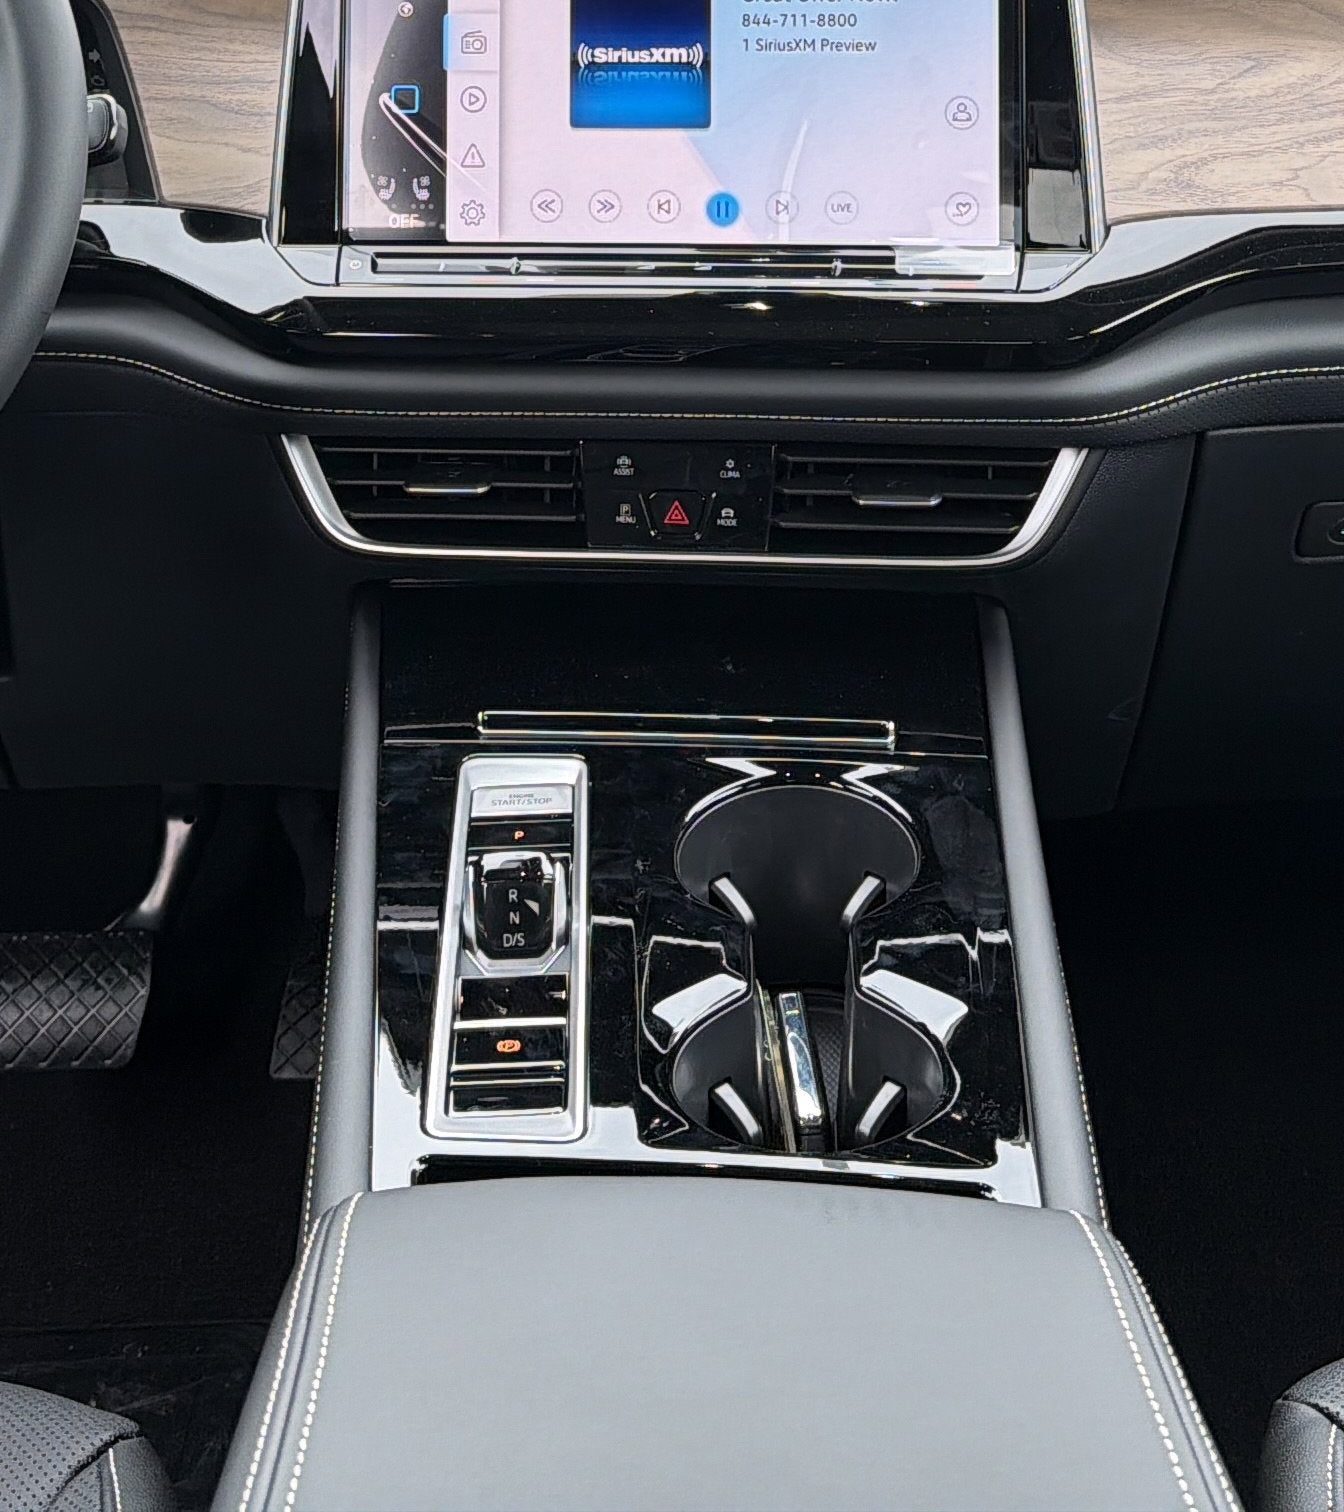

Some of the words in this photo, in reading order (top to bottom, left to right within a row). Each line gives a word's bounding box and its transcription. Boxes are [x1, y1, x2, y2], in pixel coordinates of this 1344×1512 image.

[741, 13, 858, 28] 844-711-8800
[743, 38, 750, 52] 1
[755, 38, 816, 54] SiriusXM
[821, 39, 877, 53] Preview
[830, 202, 853, 214] LIVE
[613, 467, 635, 476] ASSIST
[719, 470, 741, 479] CLIMA
[615, 515, 637, 524] MENU
[716, 518, 738, 527] MODE
[491, 797, 553, 807] START/STOP
[514, 830, 525, 840] P
[508, 889, 518, 903] R
[509, 911, 520, 925] N
[502, 933, 526, 948] D/S
